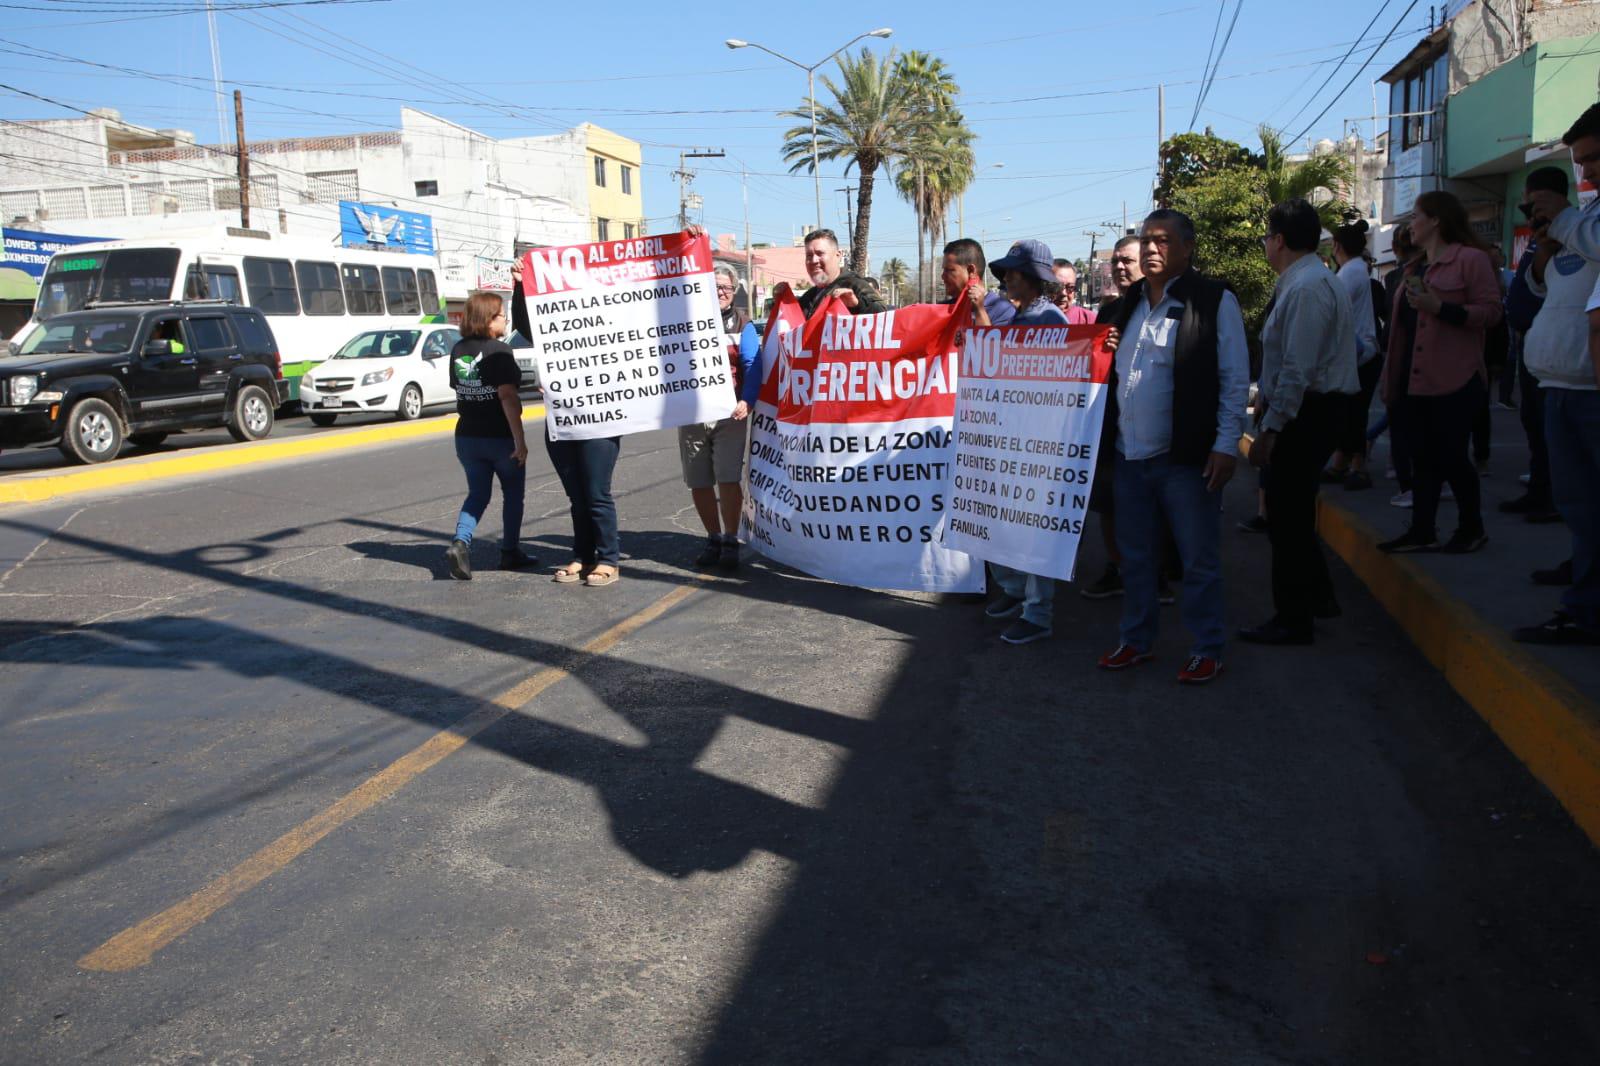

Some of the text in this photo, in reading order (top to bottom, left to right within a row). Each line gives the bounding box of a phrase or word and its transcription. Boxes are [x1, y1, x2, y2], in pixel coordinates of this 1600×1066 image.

[588, 237, 667, 263] AL CARRIL
[531, 247, 586, 294] NO
[586, 254, 700, 285] PREFERENCIAL
[536, 282, 702, 316] MATA LA ECONOMÍA DE
[539, 322, 559, 335] LA
[543, 318, 716, 354] PROMUEVE EL CIERRE DE
[821, 311, 901, 350] ARRIL
[1003, 328, 1069, 349] AL CARRIL
[546, 336, 720, 373] FUENTES DE EMPLEOS
[963, 328, 1001, 378] NO
[1001, 354, 1091, 379] PREFERENCIAL
[550, 354, 724, 393] QUEDANDO SIN
[552, 373, 726, 410] SUSTENTO NUMEROSAS
[985, 389, 999, 402] LA
[1002, 389, 1064, 407] ECONOMÍA
[1066, 393, 1086, 409] DE
[555, 409, 627, 427] FAMILIAS.
[830, 436, 859, 453] DE
[865, 435, 888, 452] LA
[958, 431, 1091, 460] PROMUEVE EL CIERRE DE
[841, 466, 869, 483] DE
[874, 462, 949, 482] FUENT
[956, 453, 1089, 485] FUENTES DE EMPLEOS
[954, 475, 1086, 510] QUEDANDO SIN
[950, 518, 990, 541] FAMILIAS.
[952, 497, 1082, 535] SUSTENTO NUMEROSAS
[801, 522, 943, 544] NUMEROS
